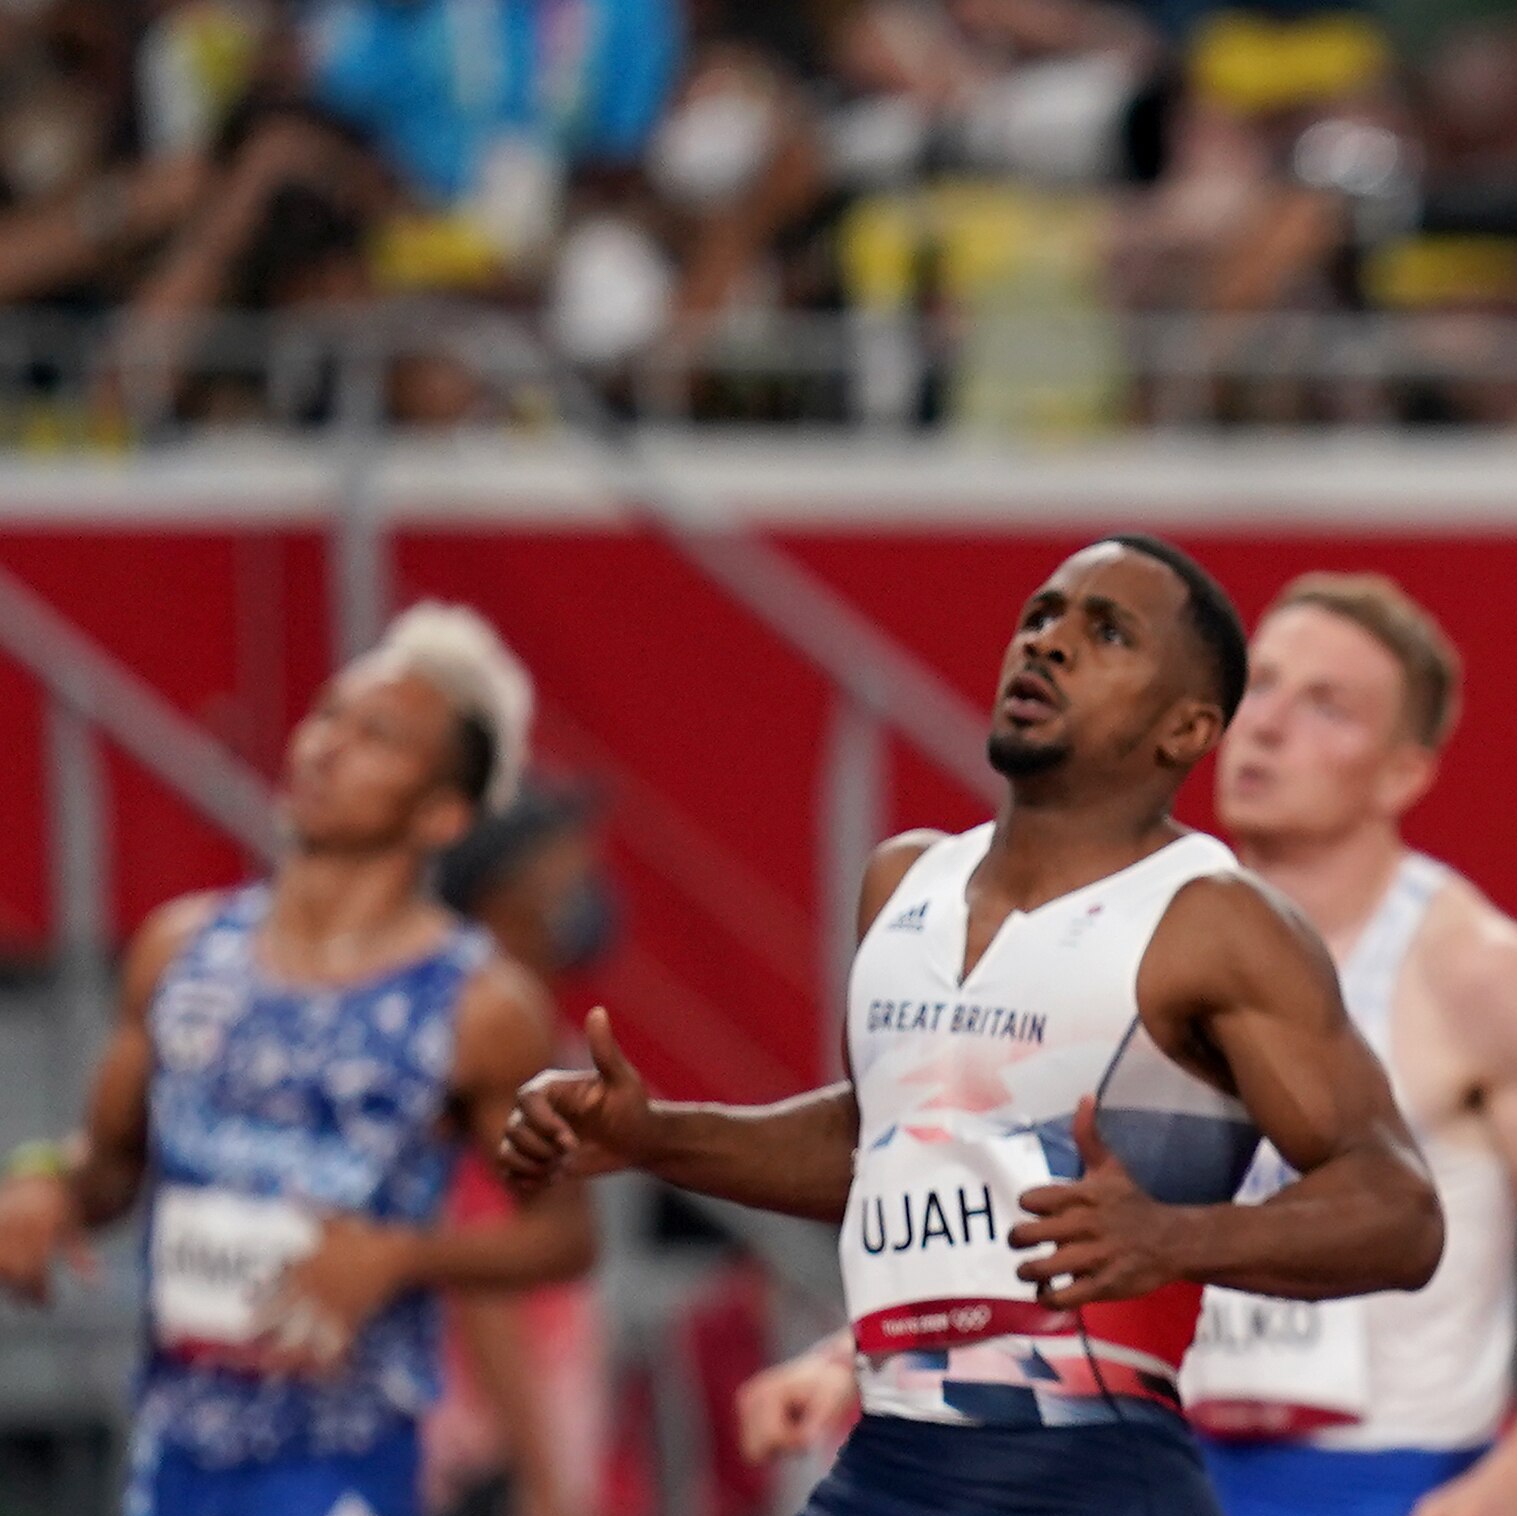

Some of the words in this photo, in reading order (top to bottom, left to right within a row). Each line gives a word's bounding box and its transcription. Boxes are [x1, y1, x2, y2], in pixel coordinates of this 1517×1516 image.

[867, 999, 948, 1033] GREAT
[949, 1003, 1047, 1044] BRITAIN
[862, 1183, 996, 1254] UJAH
